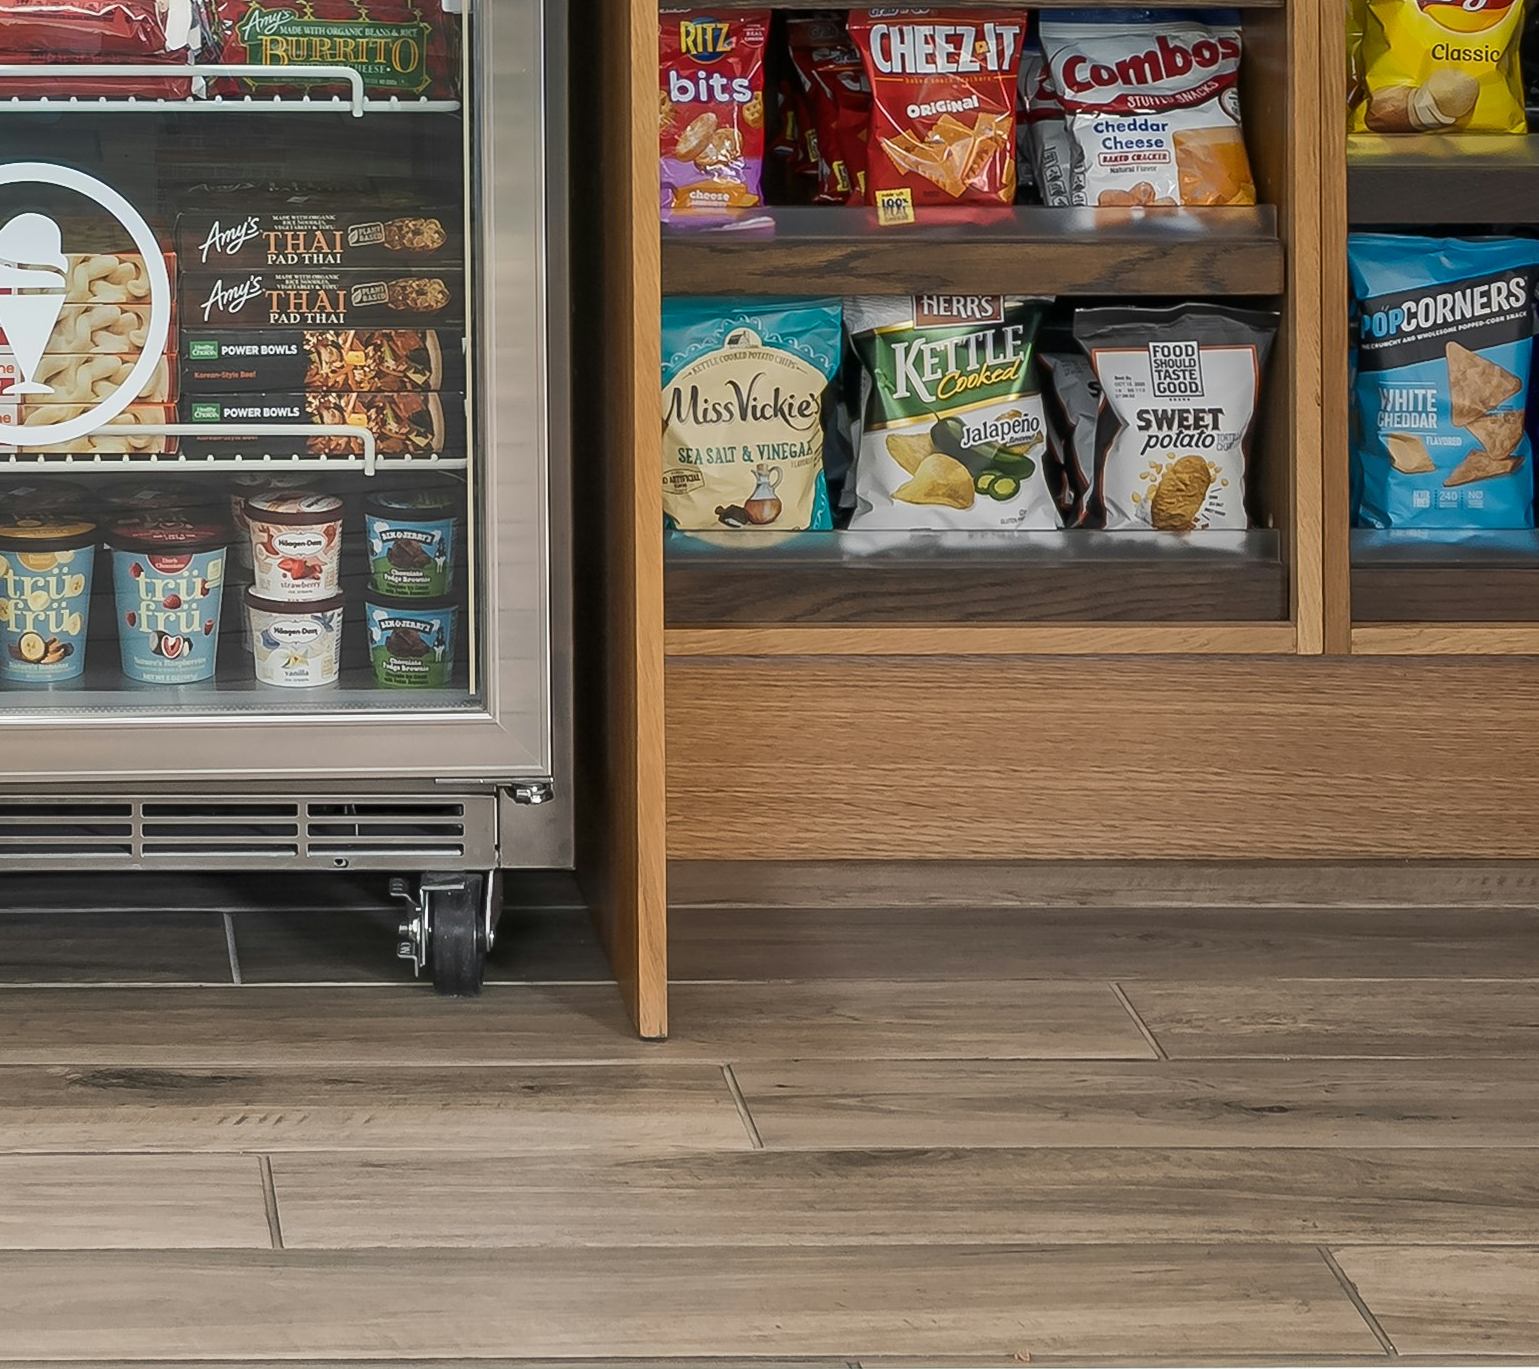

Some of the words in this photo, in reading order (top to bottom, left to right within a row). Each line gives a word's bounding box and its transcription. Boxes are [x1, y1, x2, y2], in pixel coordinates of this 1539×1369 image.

[241, 8, 294, 40] Amy's
[678, 19, 731, 55] RITZ
[261, 33, 421, 73] BURRITO
[871, 23, 1021, 75] CHEEZ-IT
[1431, 43, 1501, 64] Classic
[1062, 32, 1239, 93] Combos
[669, 68, 752, 103] bits
[1093, 117, 1168, 134] Cheddar
[1101, 135, 1164, 150] Cheese
[1102, 153, 1131, 164] BAKED
[1133, 152, 1169, 163] CRACKER
[262, 229, 345, 255] THAI
[266, 252, 297, 265] PAD
[301, 252, 343, 265] THAI
[923, 295, 994, 320] HERR'S
[1360, 276, 1527, 337] POPCORNERS
[221, 343, 256, 357] POWER
[259, 343, 298, 357] BOWLS
[891, 325, 1024, 401] KETTLE
[1153, 344, 1195, 357] FOOD
[1154, 357, 1197, 369] SHOULD
[937, 360, 1020, 400] Cooked
[1154, 369, 1198, 382] TASTE
[667, 384, 731, 425] Miss
[728, 371, 825, 423] Vickie's
[1378, 387, 1438, 413] WHITE
[962, 411, 1040, 449] Jalapeño
[1136, 408, 1225, 431] SWEET
[678, 446, 703, 465] SEA
[705, 446, 738, 464] SALT
[741, 445, 753, 462] &
[1140, 431, 1215, 455] potato
[4, 564, 74, 601] trü
[6, 598, 71, 634] frü
